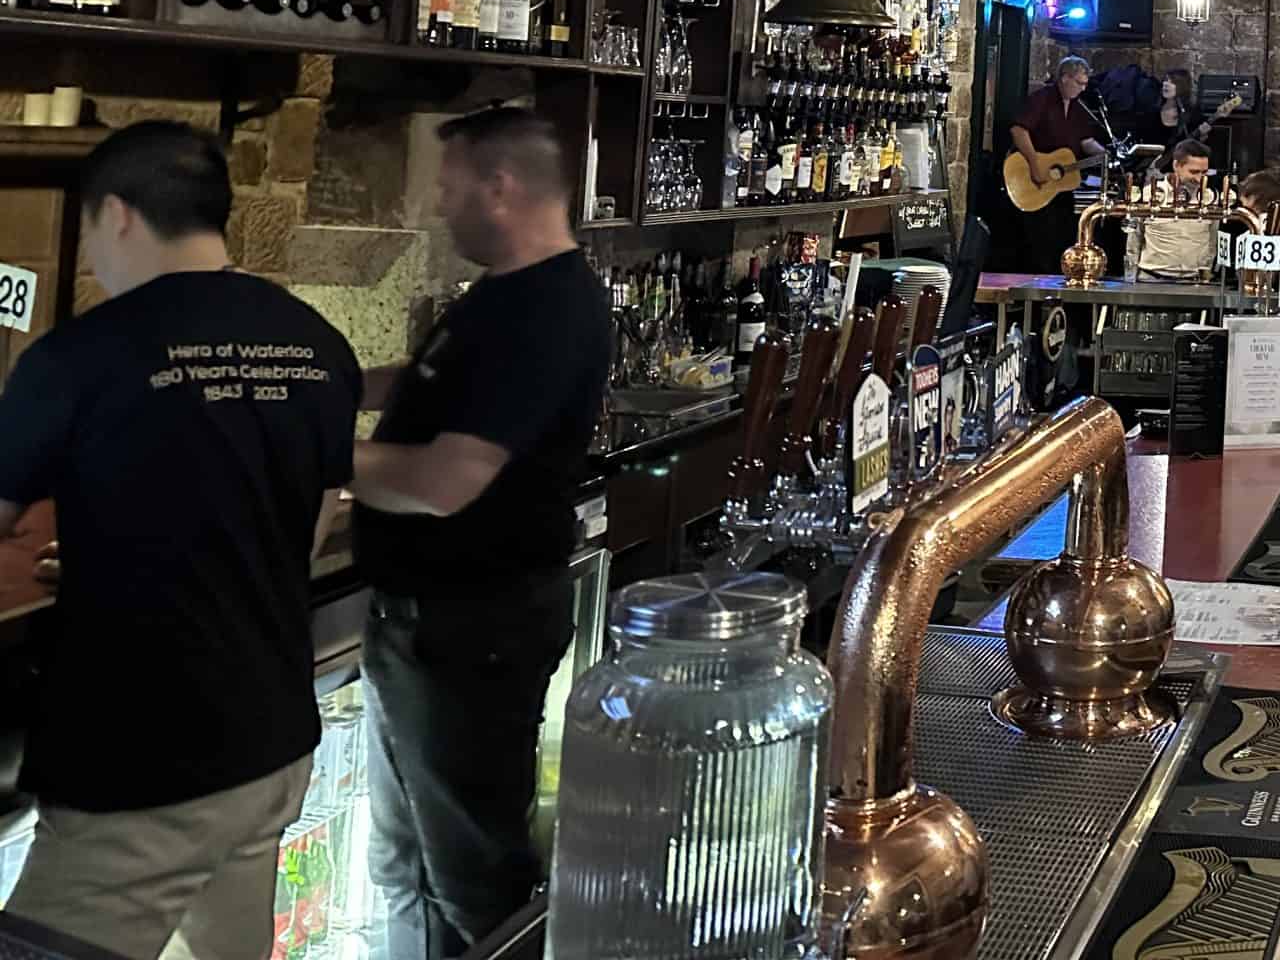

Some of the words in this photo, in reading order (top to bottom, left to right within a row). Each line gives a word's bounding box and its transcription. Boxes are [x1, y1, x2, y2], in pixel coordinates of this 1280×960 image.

[1250, 240, 1275, 264] 83
[0, 275, 28, 318] 28
[167, 344, 213, 360] Hero
[216, 343, 234, 358] of
[236, 344, 314, 359] Waterloo
[185, 365, 238, 381] Years
[913, 388, 940, 433] NEW
[1241, 791, 1269, 826] GUINNESS
